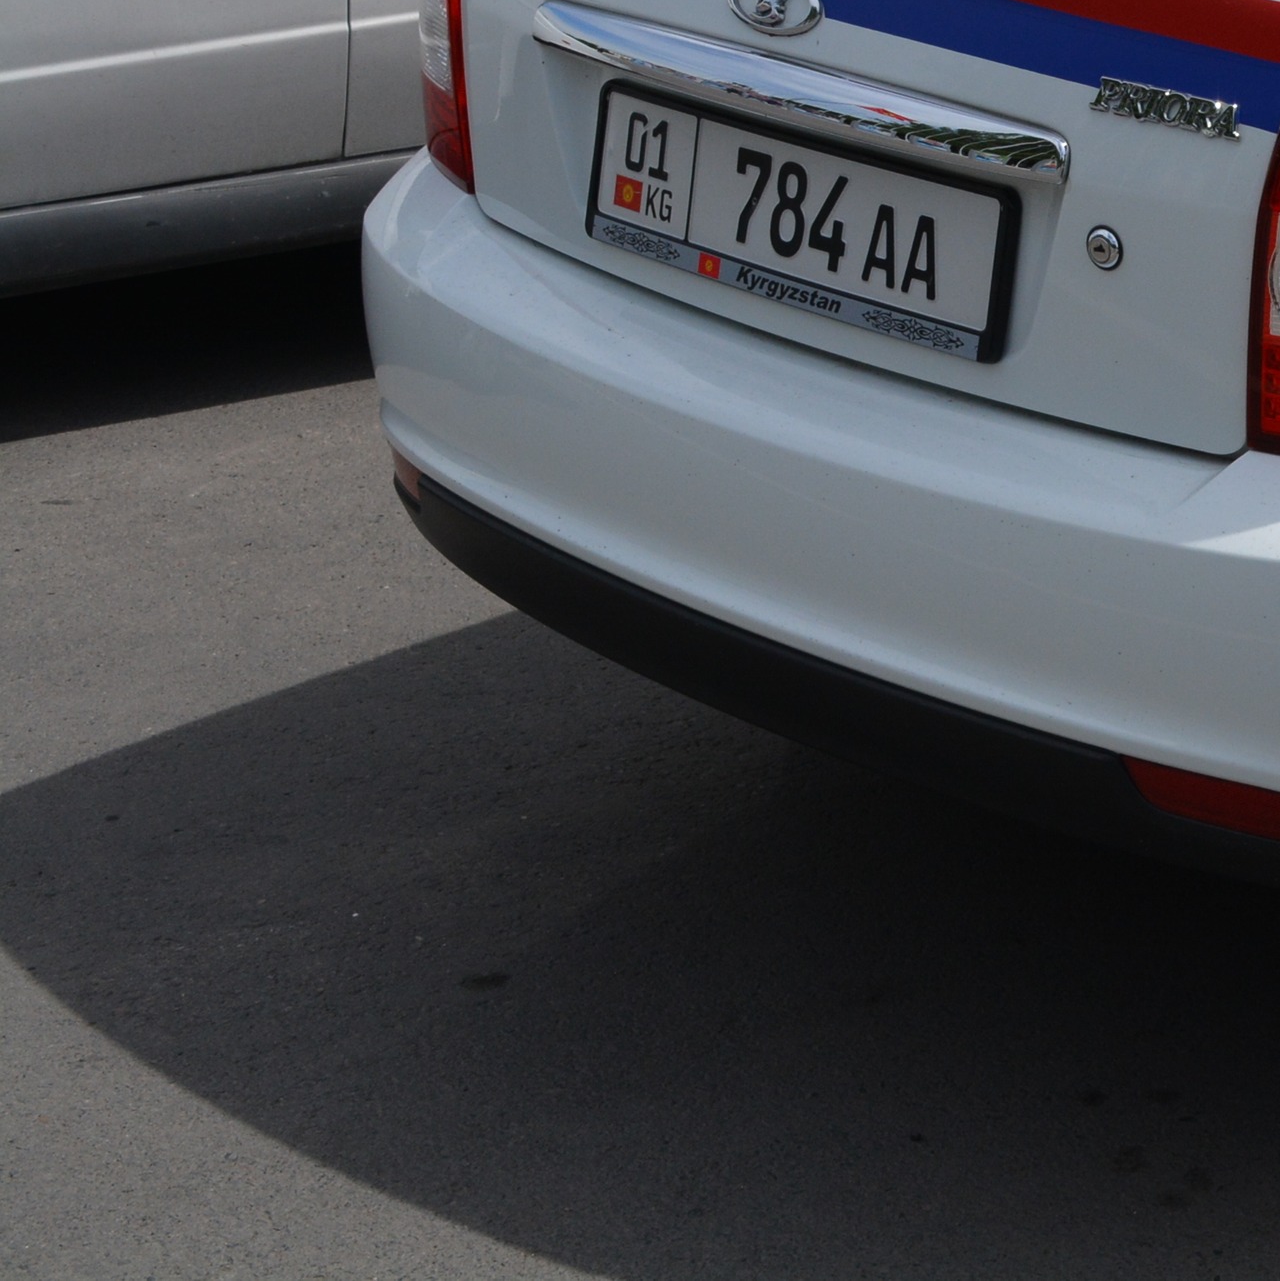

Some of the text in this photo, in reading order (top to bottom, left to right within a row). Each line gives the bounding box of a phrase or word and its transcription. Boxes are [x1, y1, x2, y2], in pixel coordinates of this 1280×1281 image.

[1089, 75, 1241, 142] PRIORA
[624, 111, 937, 301] 01 784 AA
[645, 183, 673, 224] KG
[735, 265, 842, 315] Kyrgyzstan
